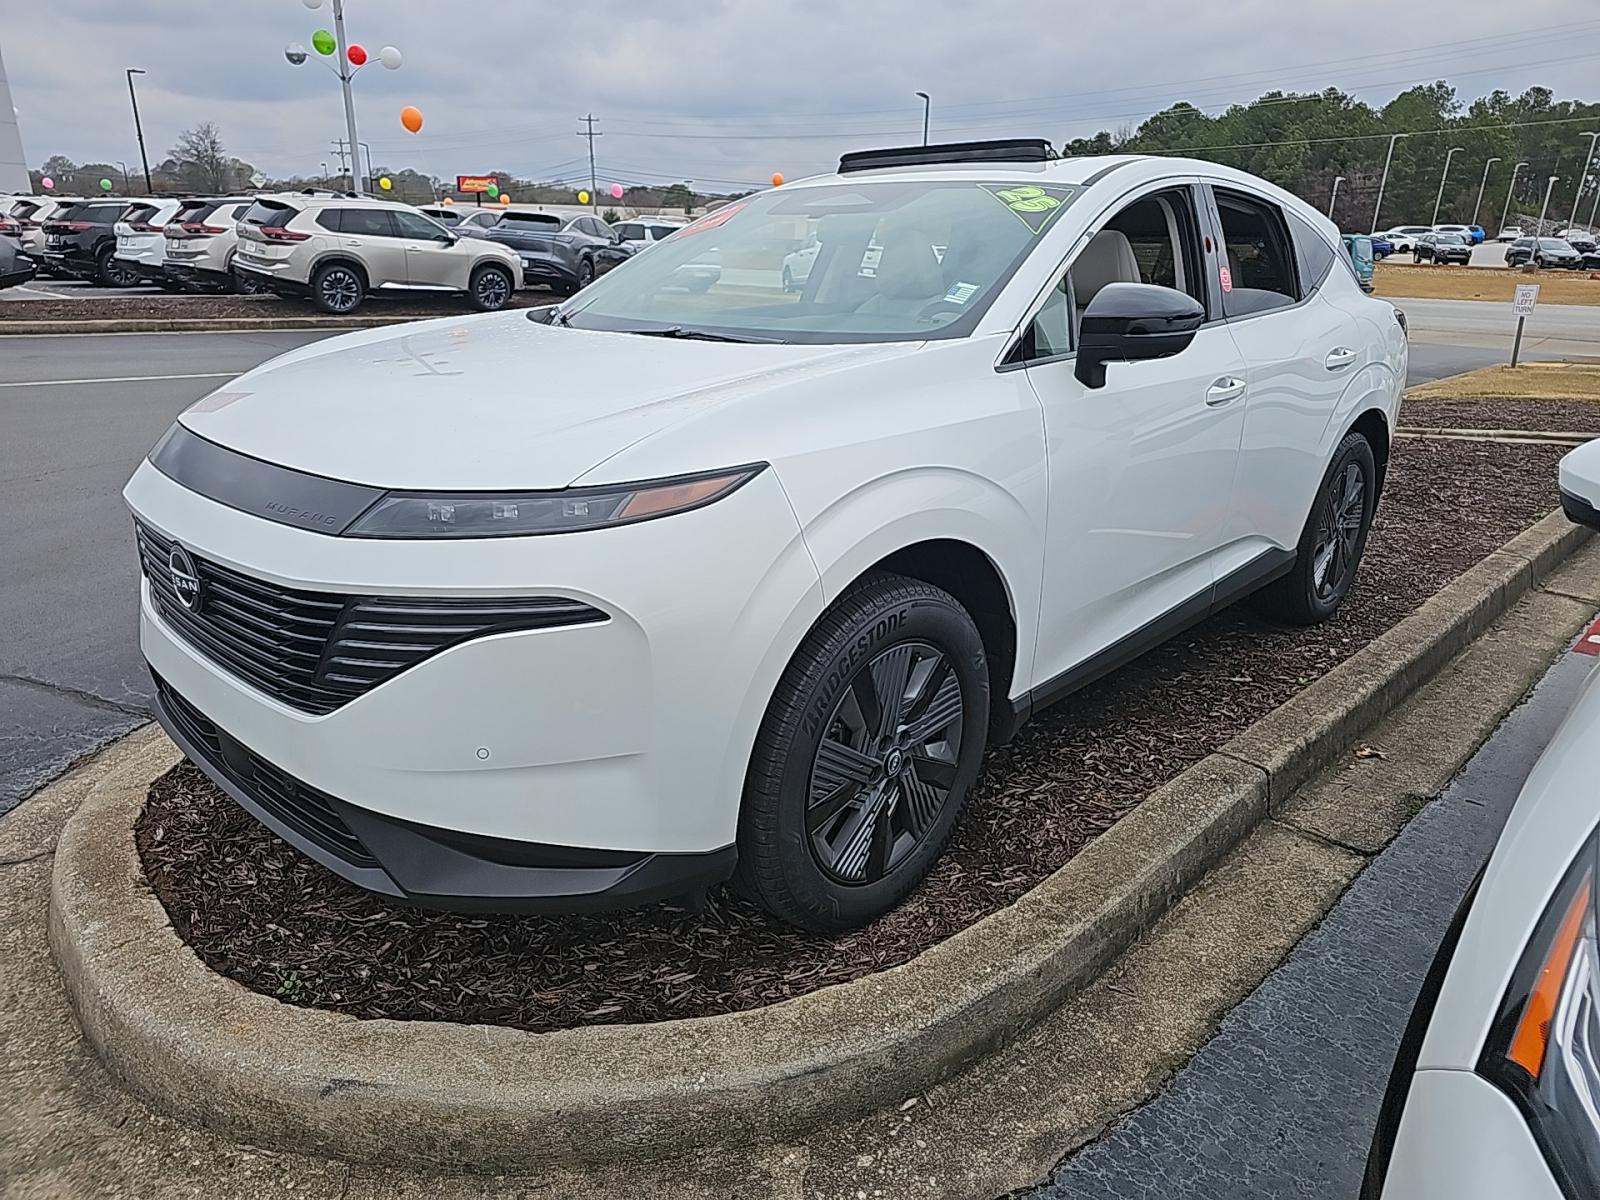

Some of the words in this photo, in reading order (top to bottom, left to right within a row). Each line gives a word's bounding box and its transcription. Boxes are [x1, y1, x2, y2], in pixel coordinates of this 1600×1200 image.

[996, 185, 1061, 213] 25
[1520, 291, 1532, 299] NO
[1514, 305, 1532, 313] TURN
[801, 608, 908, 739] BRIDGESTONE
